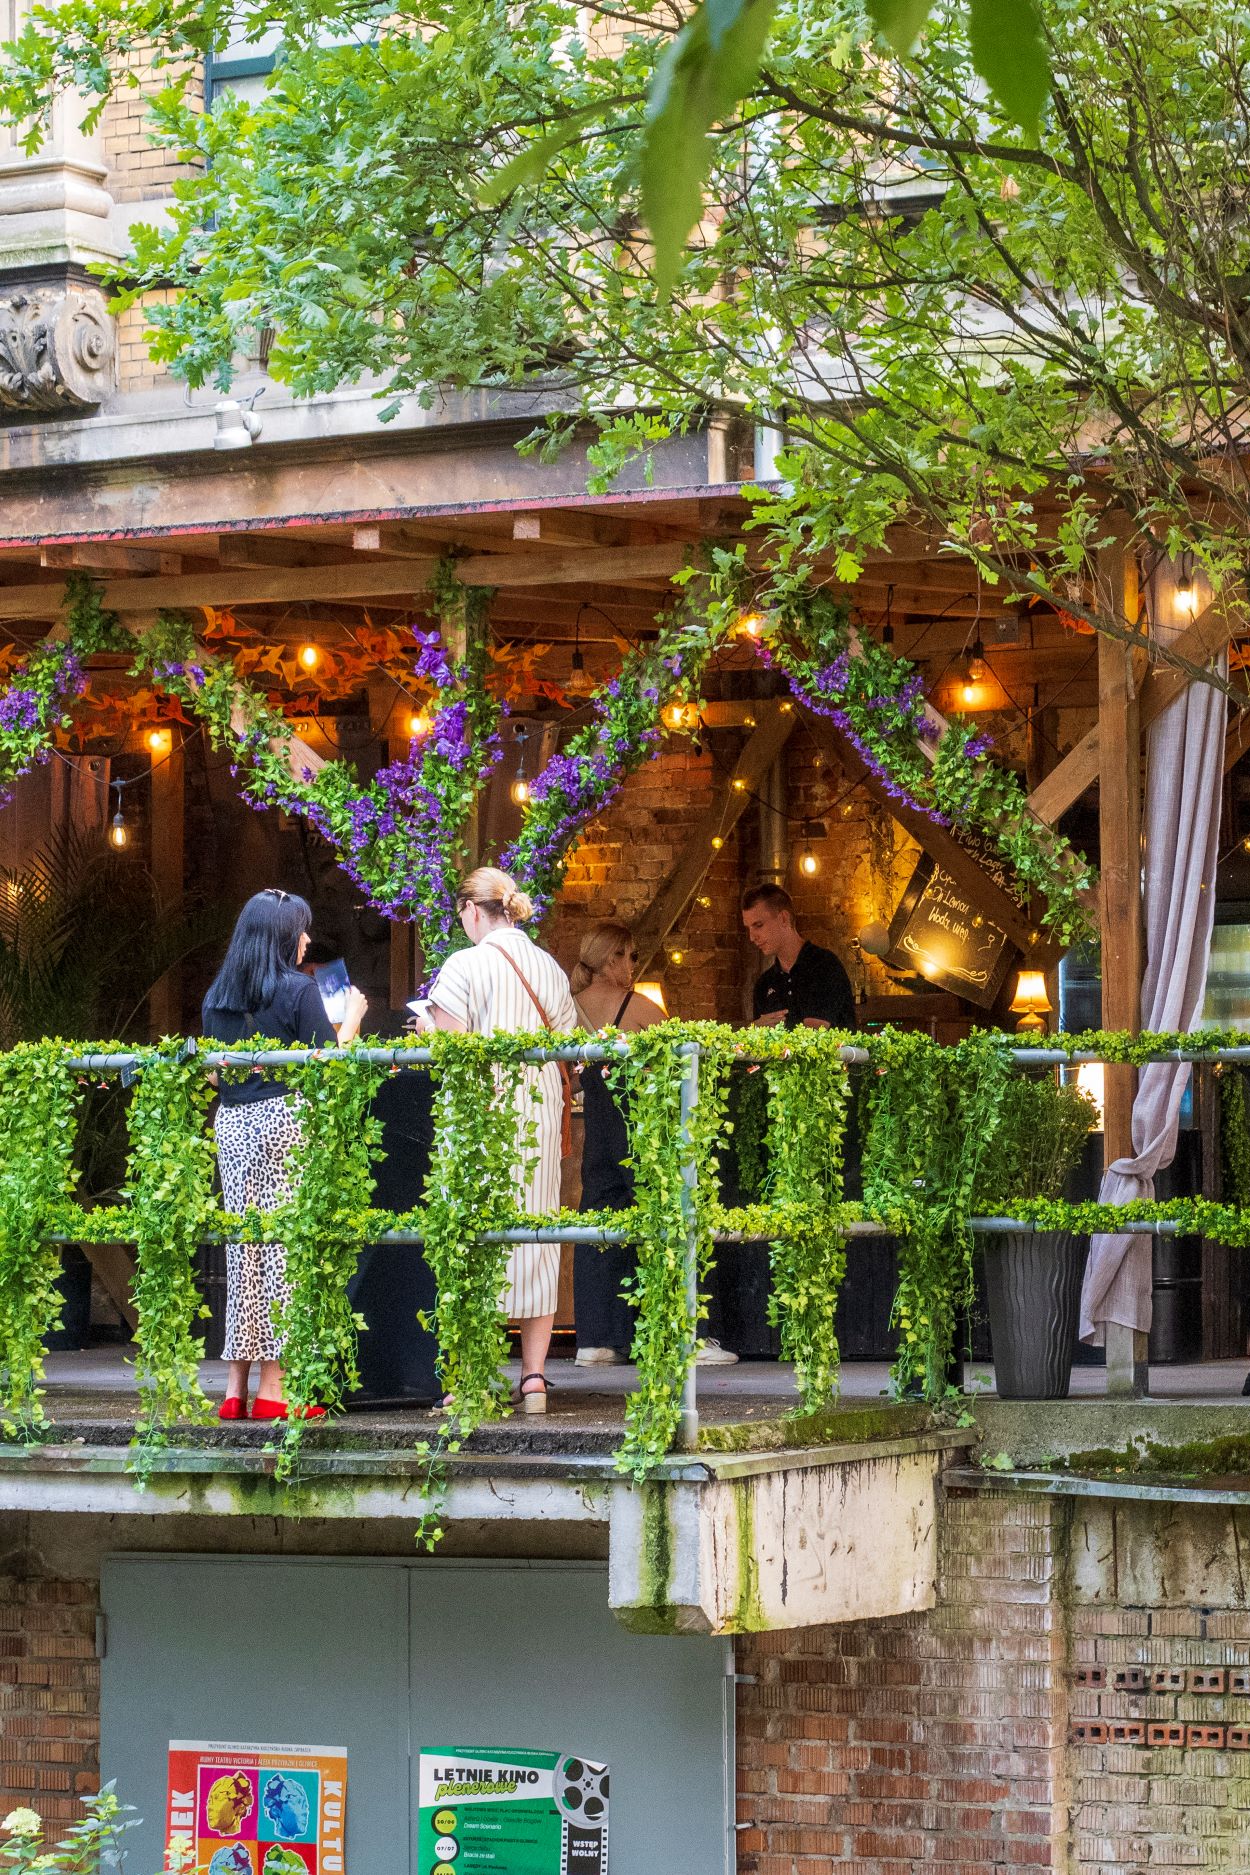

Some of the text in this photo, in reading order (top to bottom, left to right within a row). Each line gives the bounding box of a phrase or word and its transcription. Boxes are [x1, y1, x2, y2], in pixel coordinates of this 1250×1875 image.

[433, 1768, 540, 1785] LETNIE KINO
[434, 1778, 518, 1802] plenerowe
[572, 1840, 599, 1850] WSTĘP
[571, 1850, 600, 1858] WOLNY
